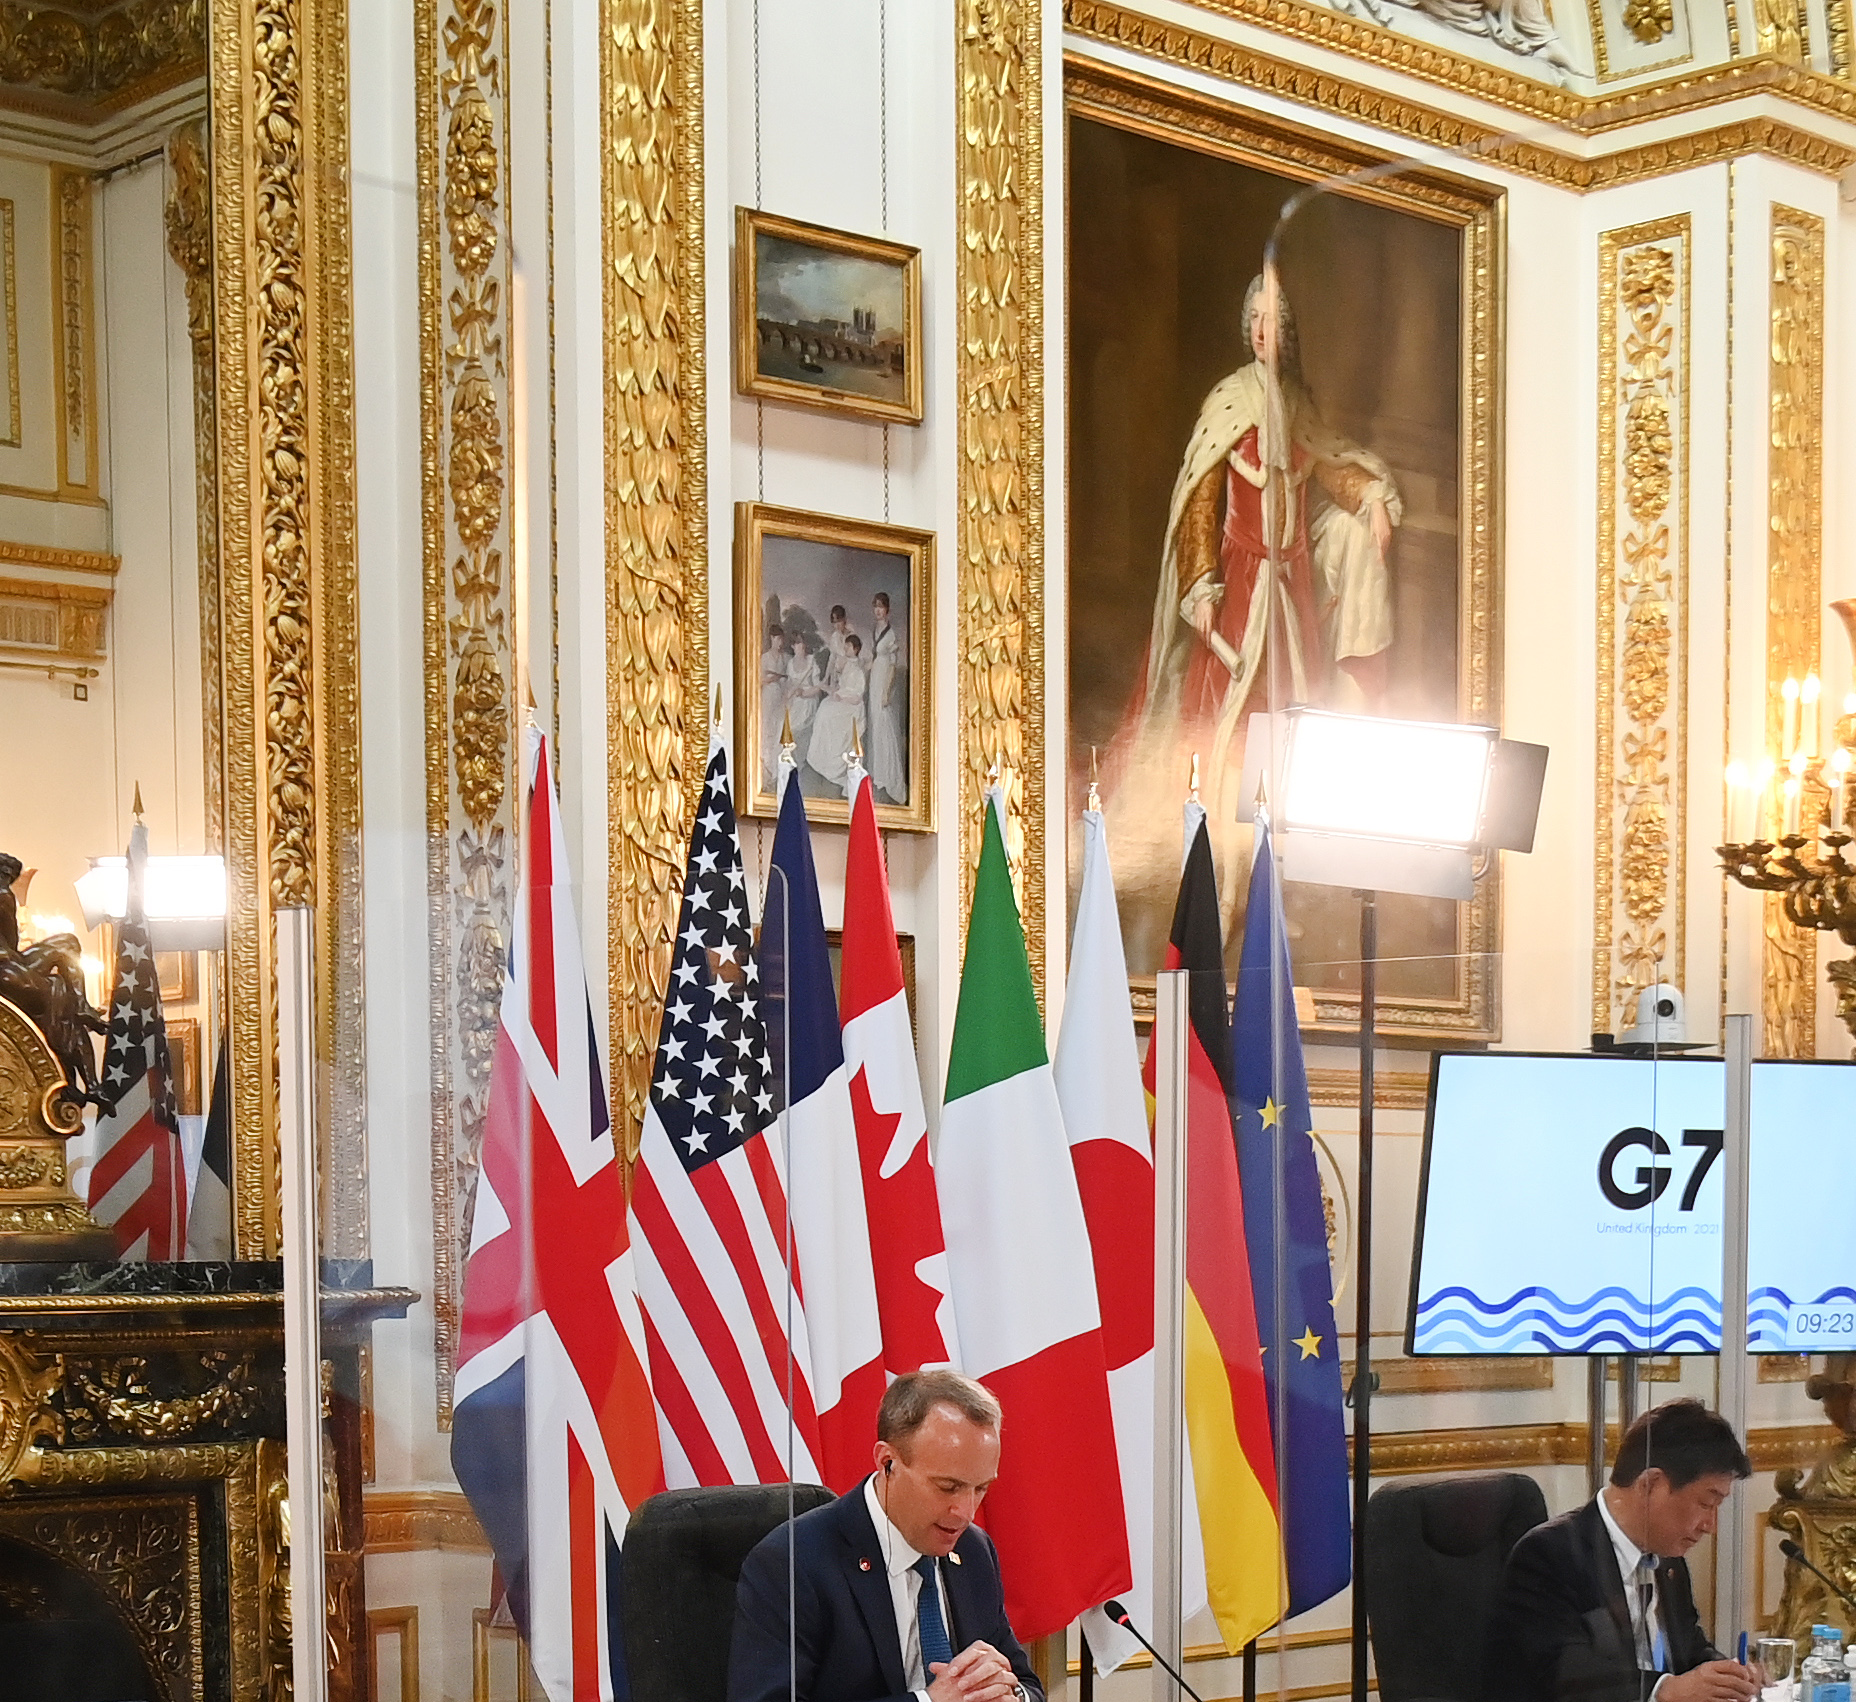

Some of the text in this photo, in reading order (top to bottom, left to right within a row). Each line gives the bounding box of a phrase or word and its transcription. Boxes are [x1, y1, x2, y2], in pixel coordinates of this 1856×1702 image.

[1597, 1127, 1724, 1211] G7
[1596, 1222, 1719, 1237] United Kingdom 2021
[1796, 1313, 1854, 1333] 09:23
